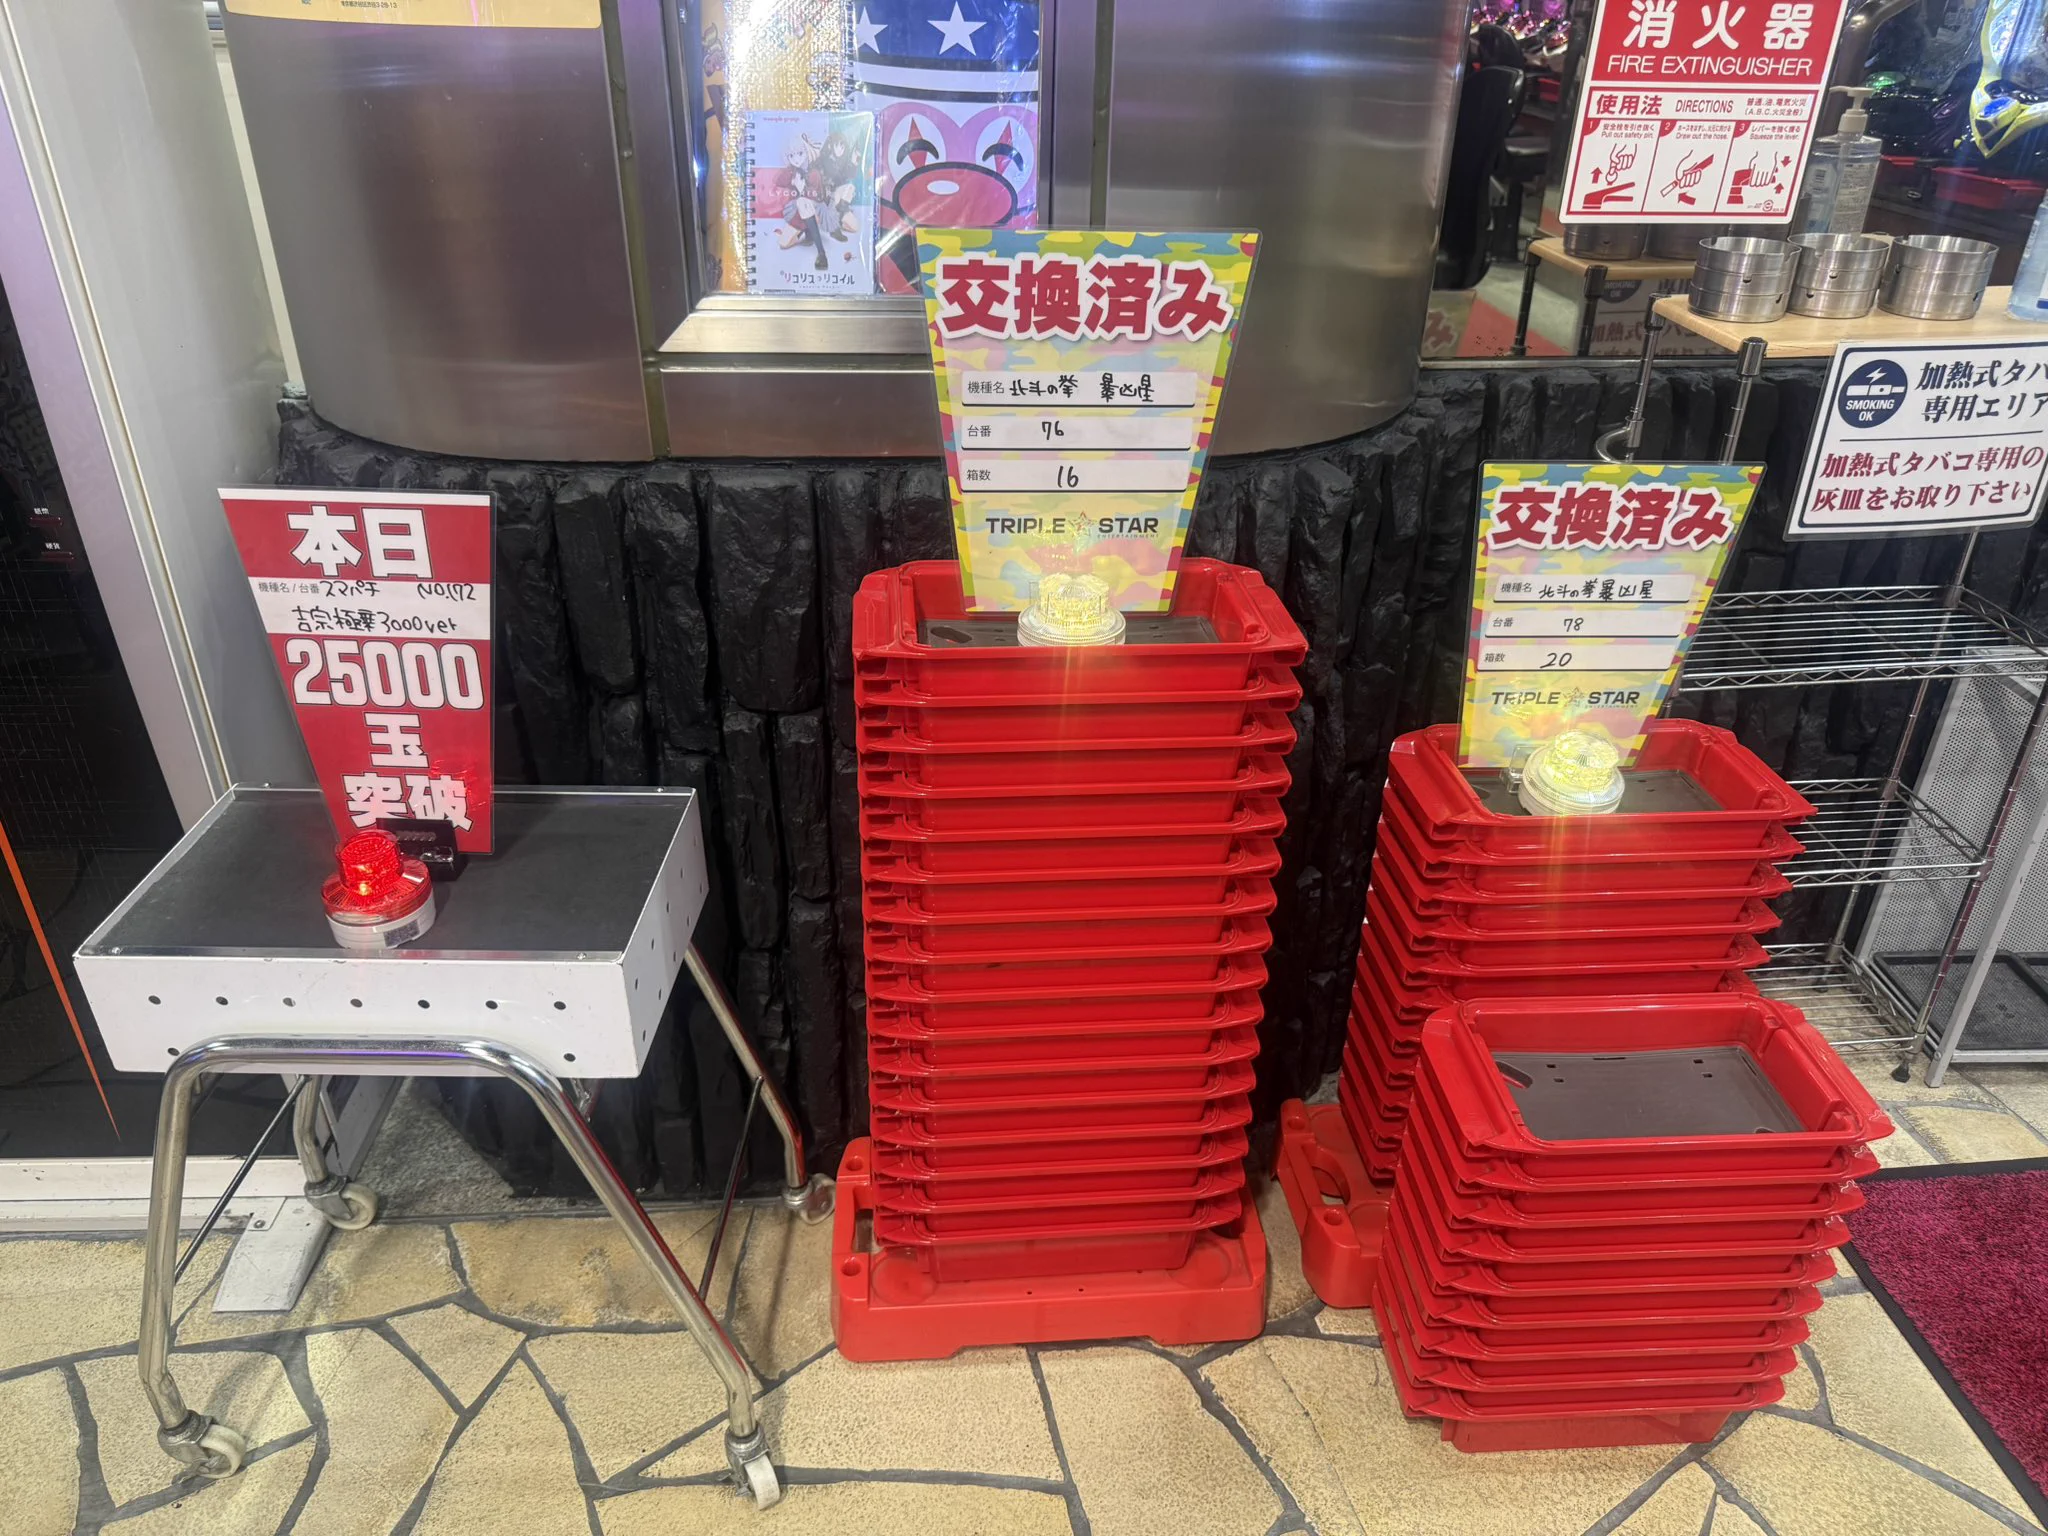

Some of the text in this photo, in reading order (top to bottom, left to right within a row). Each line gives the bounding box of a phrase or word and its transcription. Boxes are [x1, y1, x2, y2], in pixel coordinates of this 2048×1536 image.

[1622, 0, 1815, 50] 消火器
[1607, 54, 1814, 77] FIRE EXTINGUISHER
[1596, 94, 1663, 116] 使用法
[1675, 99, 1734, 114] DIRECTIONS
[1664, 122, 1671, 131] 2
[1739, 123, 1746, 132] 3
[1624, 132, 1643, 140] safety
[939, 256, 1231, 339] 交換済み
[967, 380, 1005, 394] 機種名
[1845, 399, 1896, 411] SMOKING
[1920, 392, 2048, 424] 専用エリア
[1858, 410, 1875, 422] OK
[967, 424, 992, 438] 台番
[1041, 420, 1066, 441] 76
[1818, 444, 2045, 479] 加熱式タバコ専用の
[966, 469, 992, 482] 箱数
[1056, 465, 1080, 489] 16
[1809, 479, 2032, 513] 灰皿をお取り下さい
[1489, 485, 1731, 547] 交換済み
[985, 517, 1160, 534] TRIPLE STAR
[286, 504, 434, 579] 本日
[319, 580, 381, 598] スマパチ
[1501, 582, 1533, 594] 機種名
[1492, 617, 1514, 628] 台番
[1563, 617, 1585, 633] 78
[1484, 653, 1506, 663] 箱数
[1540, 652, 1573, 669] 20
[284, 637, 485, 711] 25000
[1491, 691, 1641, 705] TRIPLE STAR
[363, 711, 430, 769] 玉
[341, 771, 474, 832] 突破
